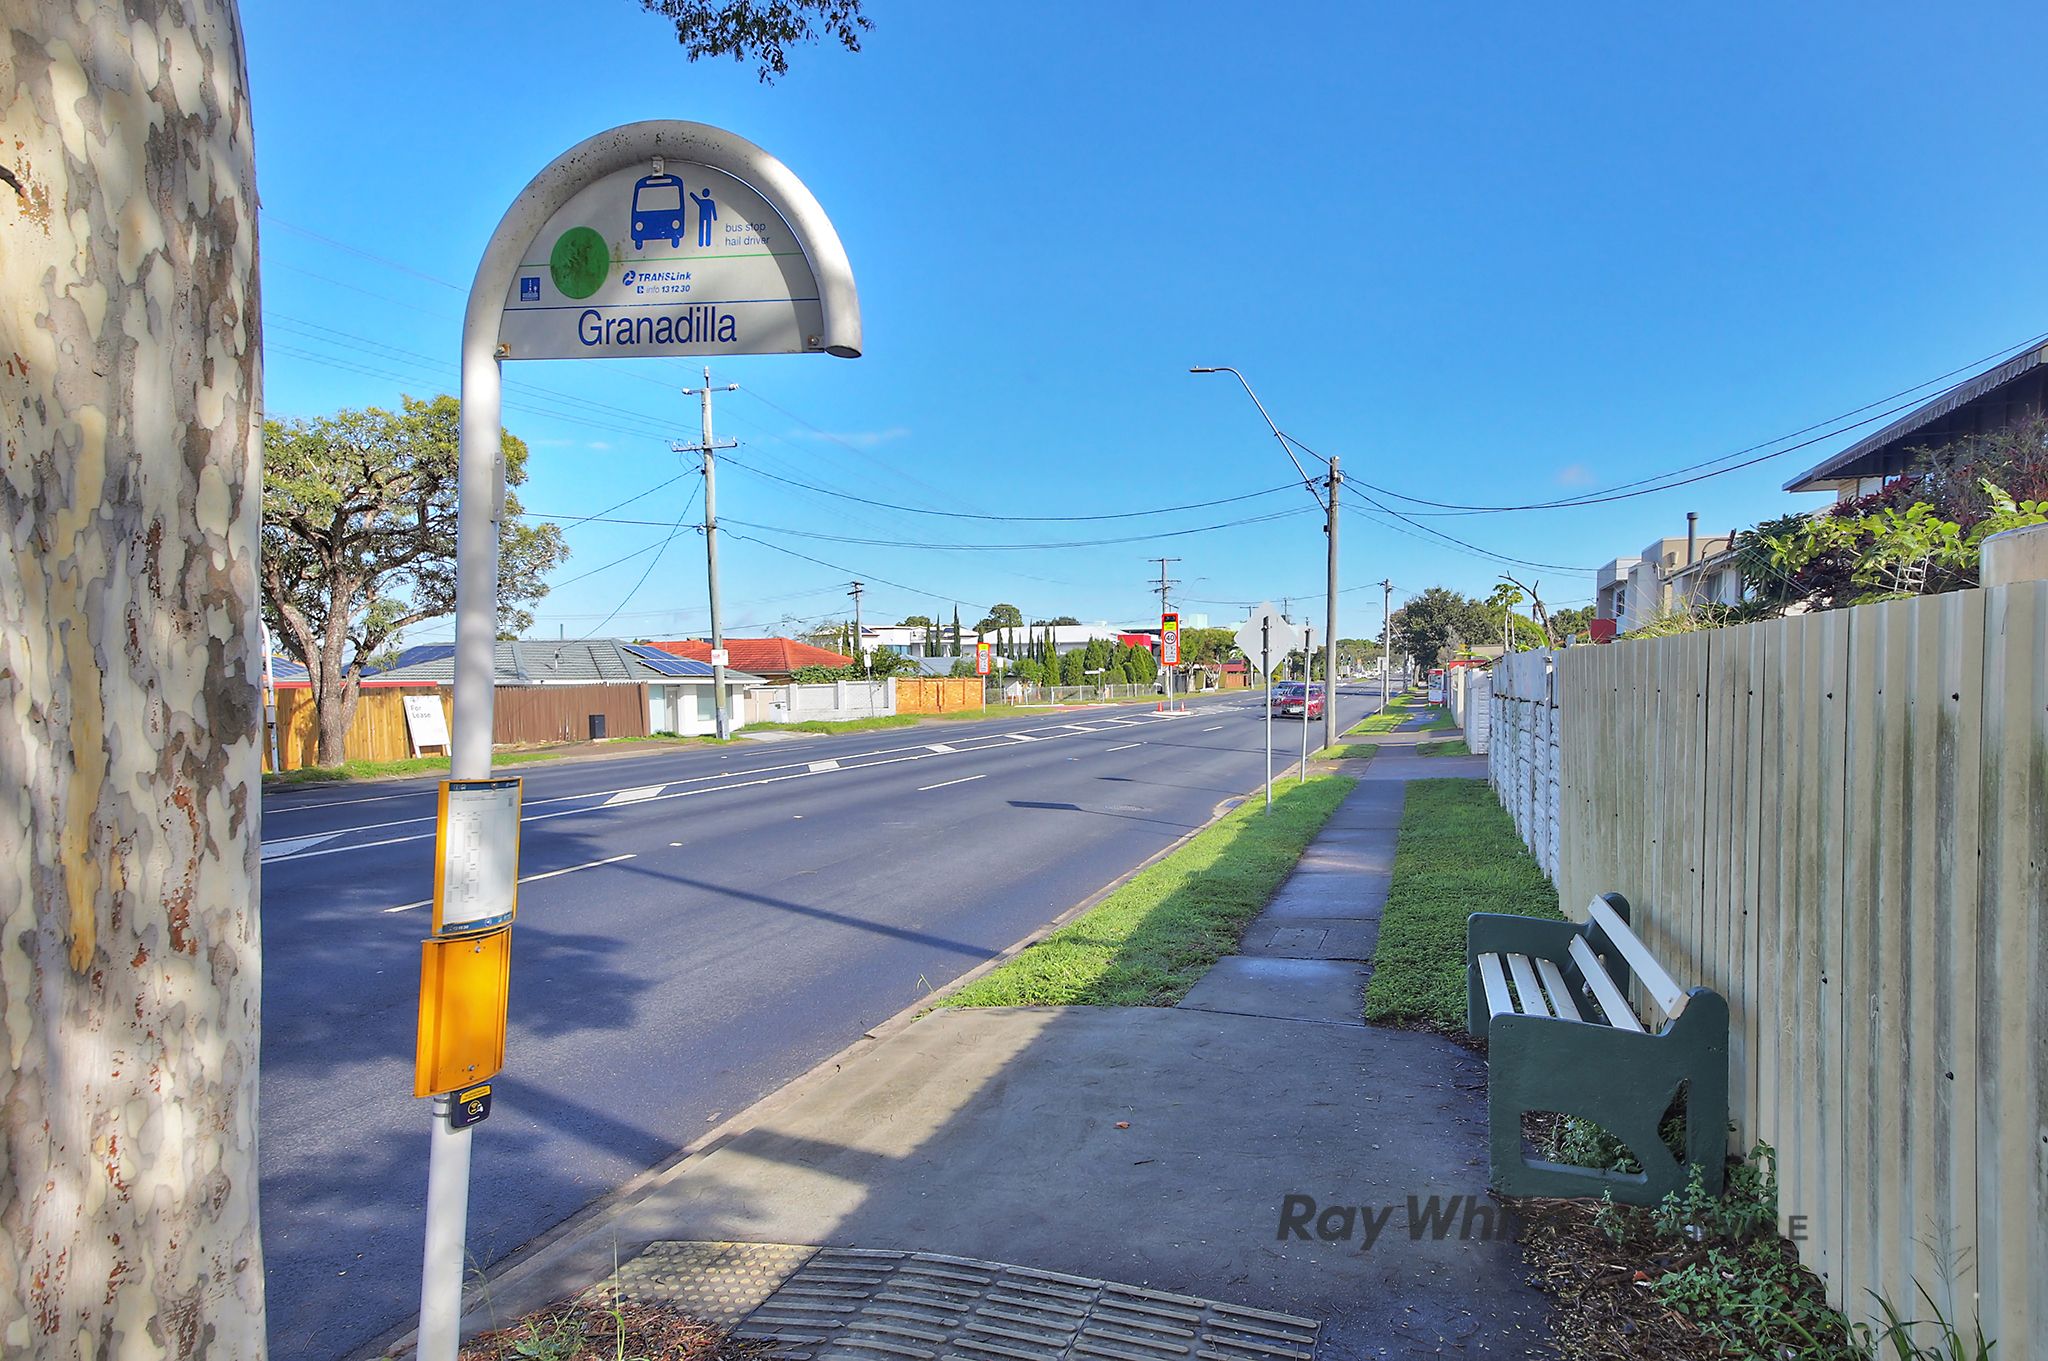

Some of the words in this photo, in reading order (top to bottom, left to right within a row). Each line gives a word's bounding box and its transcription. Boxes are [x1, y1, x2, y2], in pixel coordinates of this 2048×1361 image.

[725, 223, 743, 233] bus
[745, 222, 767, 233] stop
[725, 236, 742, 246] hail
[743, 235, 770, 246] driver
[646, 285, 660, 294] info
[578, 306, 737, 347] Granadilla
[1166, 634, 1175, 642] 40
